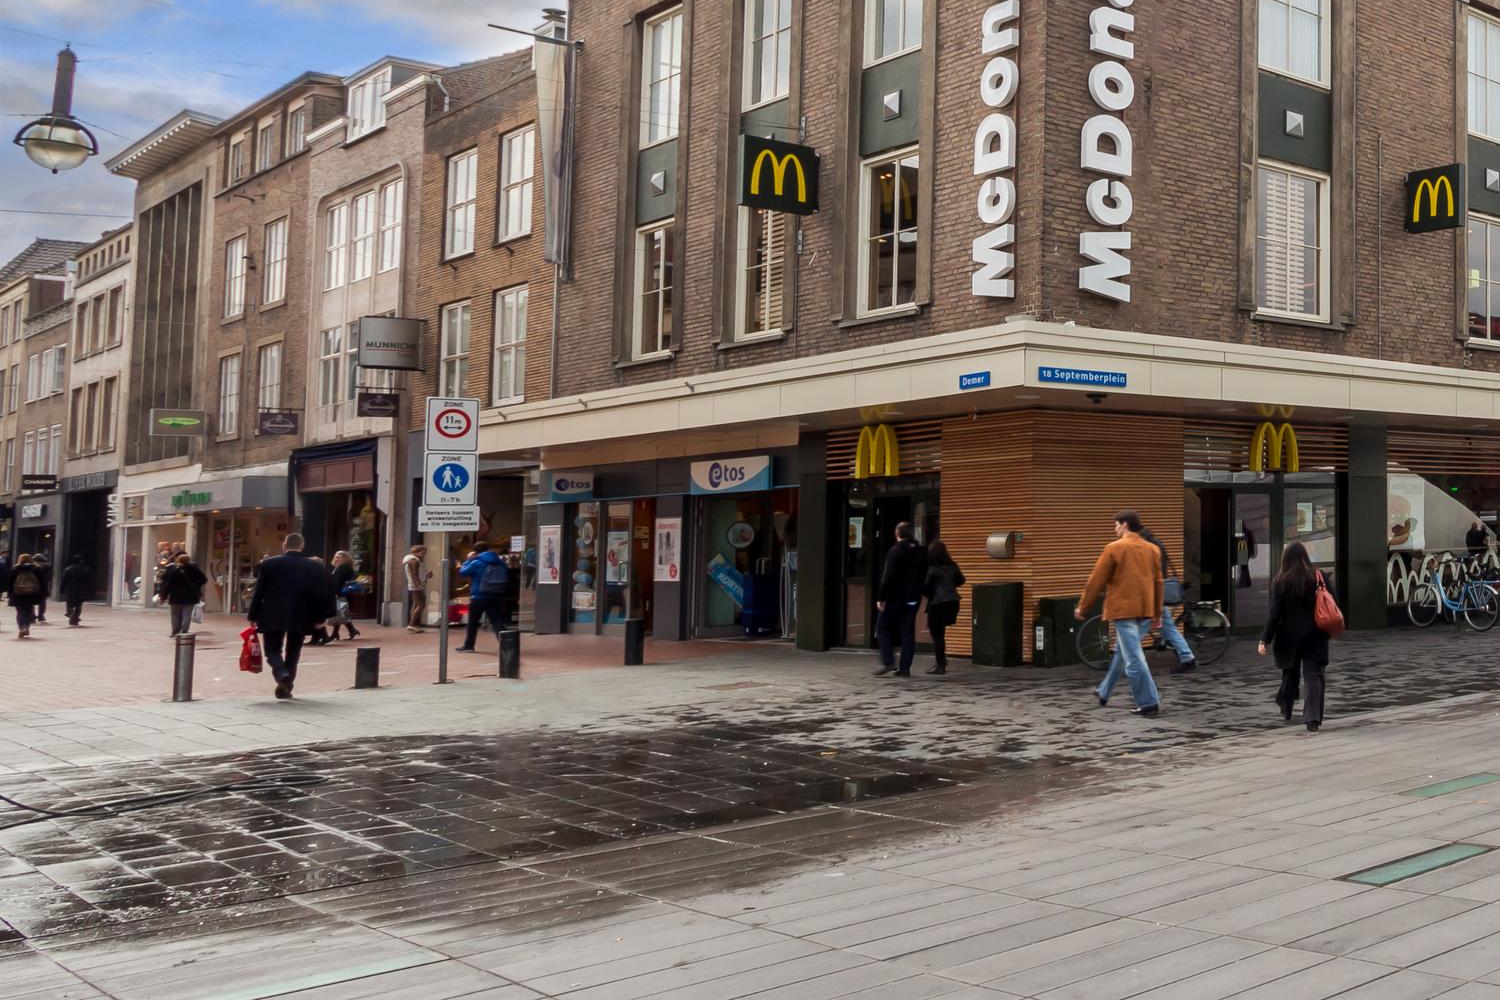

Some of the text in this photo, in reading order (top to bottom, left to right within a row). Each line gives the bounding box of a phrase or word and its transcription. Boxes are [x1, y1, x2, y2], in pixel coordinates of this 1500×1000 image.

[962, 376, 984, 386] Demer
[1042, 369, 1126, 384] 18 Septemberplein
[708, 462, 745, 488] etos
[555, 478, 591, 491] etos
